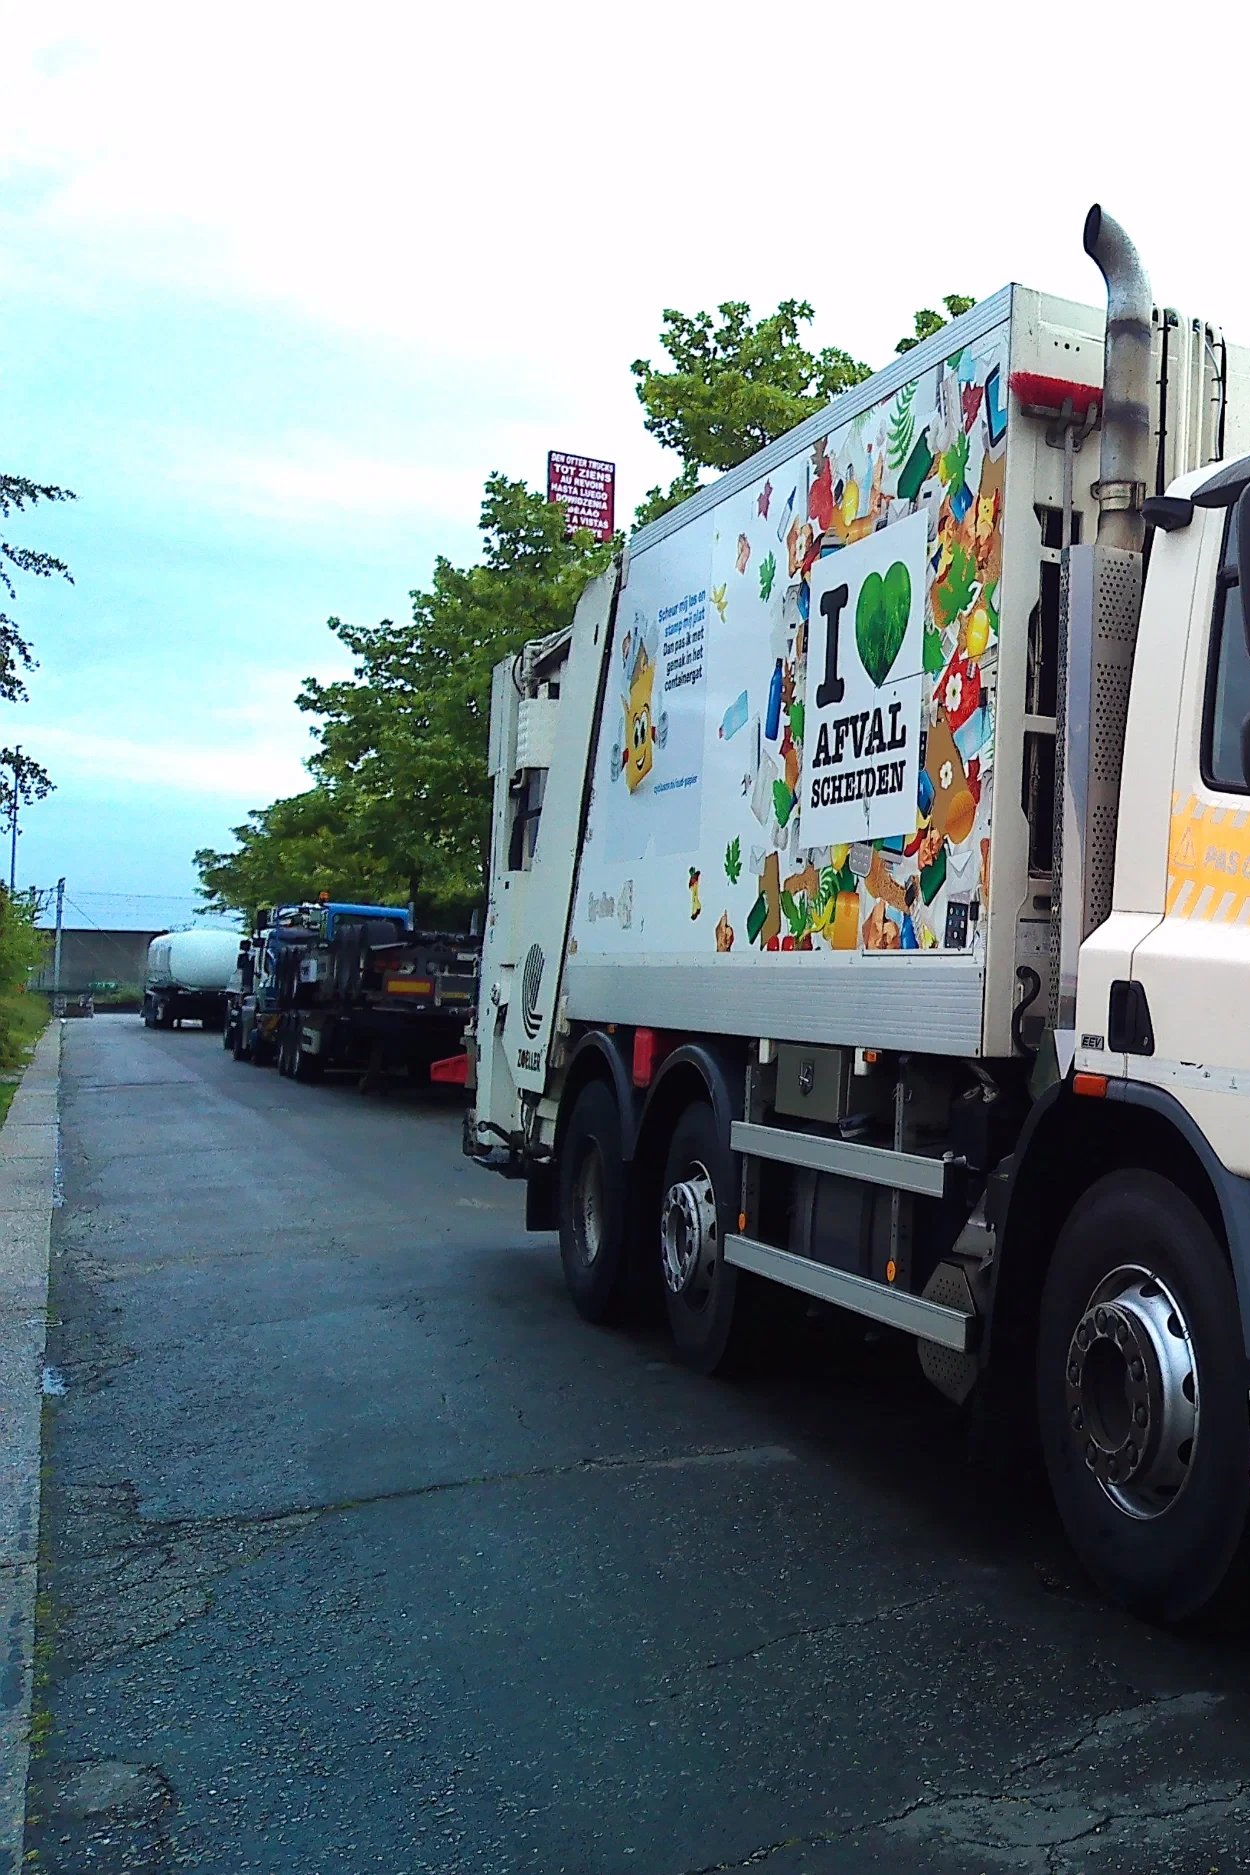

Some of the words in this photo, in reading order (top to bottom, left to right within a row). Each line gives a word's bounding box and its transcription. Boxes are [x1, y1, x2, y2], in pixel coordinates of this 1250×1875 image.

[551, 452, 566, 463] DEN
[566, 456, 587, 468] OTTER
[588, 460, 613, 473] TRUCKS
[553, 463, 576, 476] TOT
[578, 468, 612, 483] ZIENS
[551, 482, 578, 496] HASTA
[580, 488, 608, 501] LUEGO
[560, 475, 572, 485] AU
[573, 477, 604, 491] REVOIR
[580, 516, 609, 529] VISTAS
[658, 604, 679, 622] Scheur
[679, 596, 688, 613] mij
[689, 594, 698, 608] los
[698, 590, 706, 603] en
[664, 620, 682, 637] stamp
[683, 612, 692, 629] mij
[693, 606, 706, 627] plat
[663, 641, 675, 656] Dan
[675, 638, 685, 654] pas
[692, 625, 705, 643] met
[816, 583, 849, 709] I
[666, 652, 685, 676] gemak
[693, 644, 704, 661] het
[664, 664, 703, 692] containergat
[812, 702, 907, 769] AFVAL
[810, 760, 907, 808] SCHEIDEN
[1203, 845, 1241, 875] PAS
[1082, 1036, 1102, 1048] EEV
